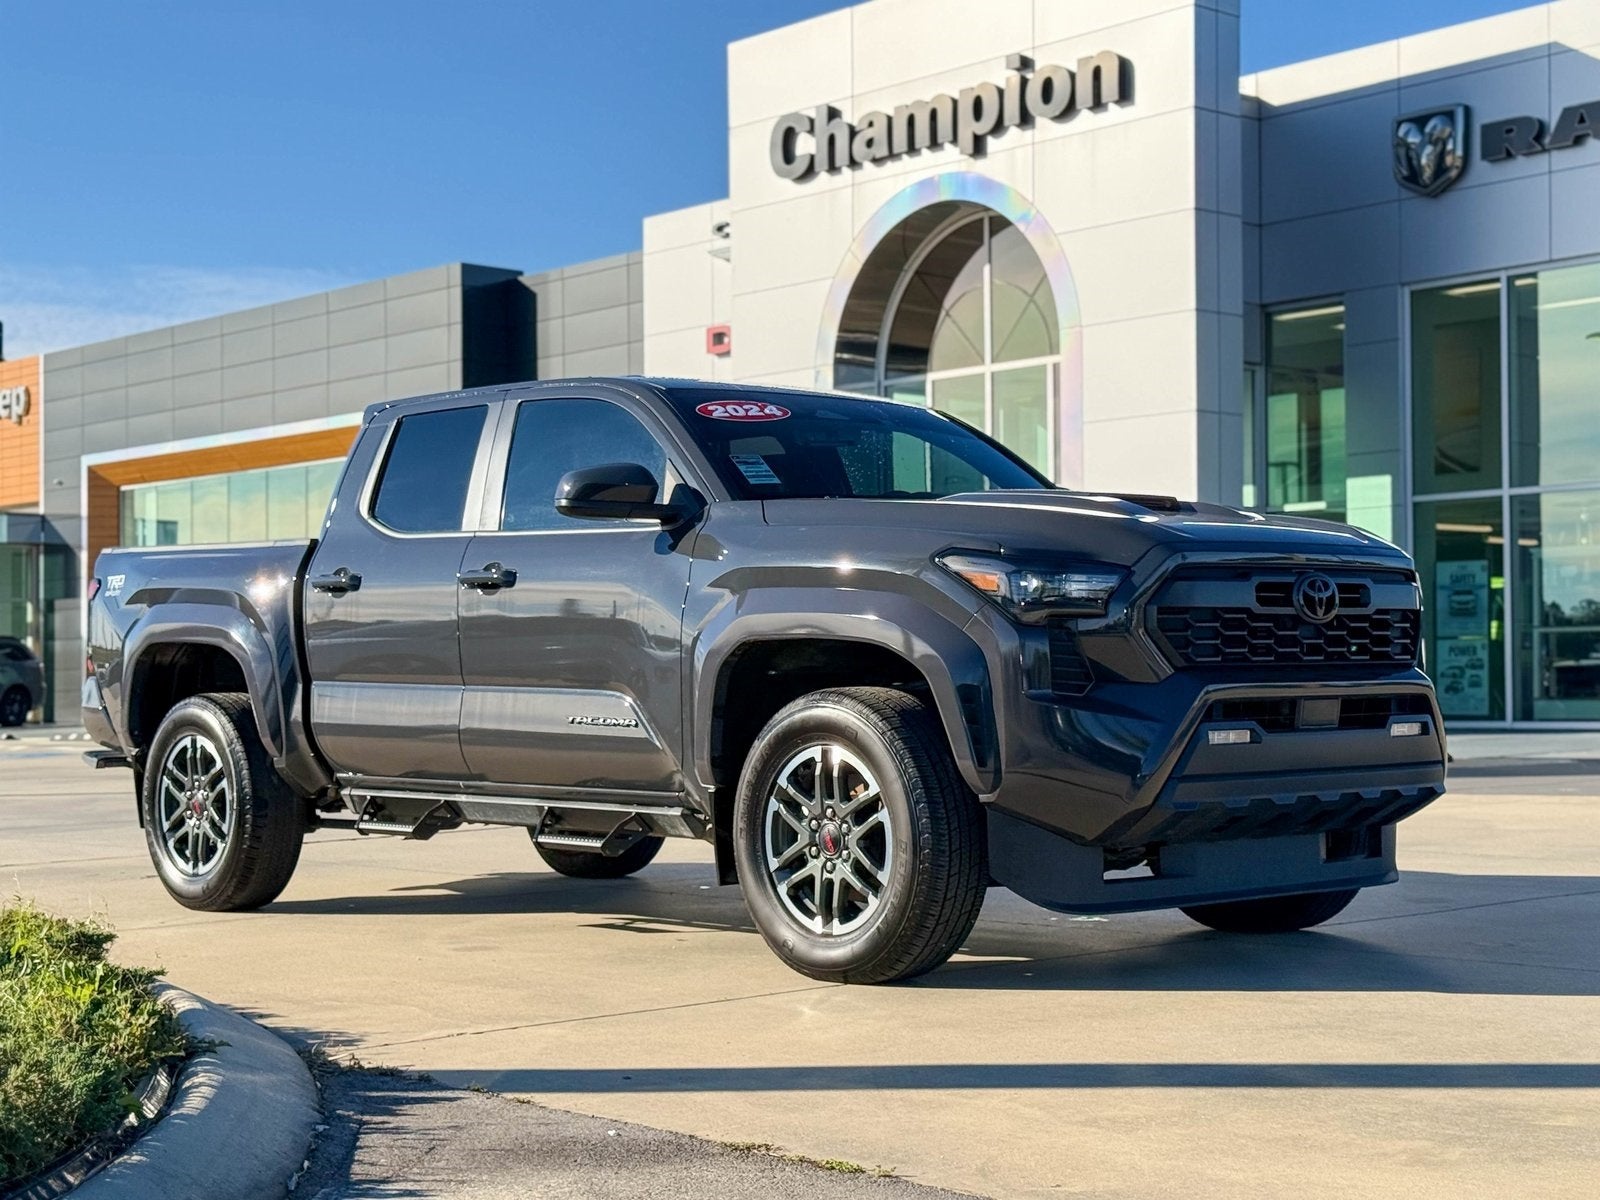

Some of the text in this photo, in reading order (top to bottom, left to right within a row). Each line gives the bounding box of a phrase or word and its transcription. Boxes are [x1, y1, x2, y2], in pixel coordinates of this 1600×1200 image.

[769, 50, 1135, 184] Champion
[707, 404, 783, 417] 2024
[107, 574, 126, 590] TRD
[567, 715, 639, 728] TACOMA
